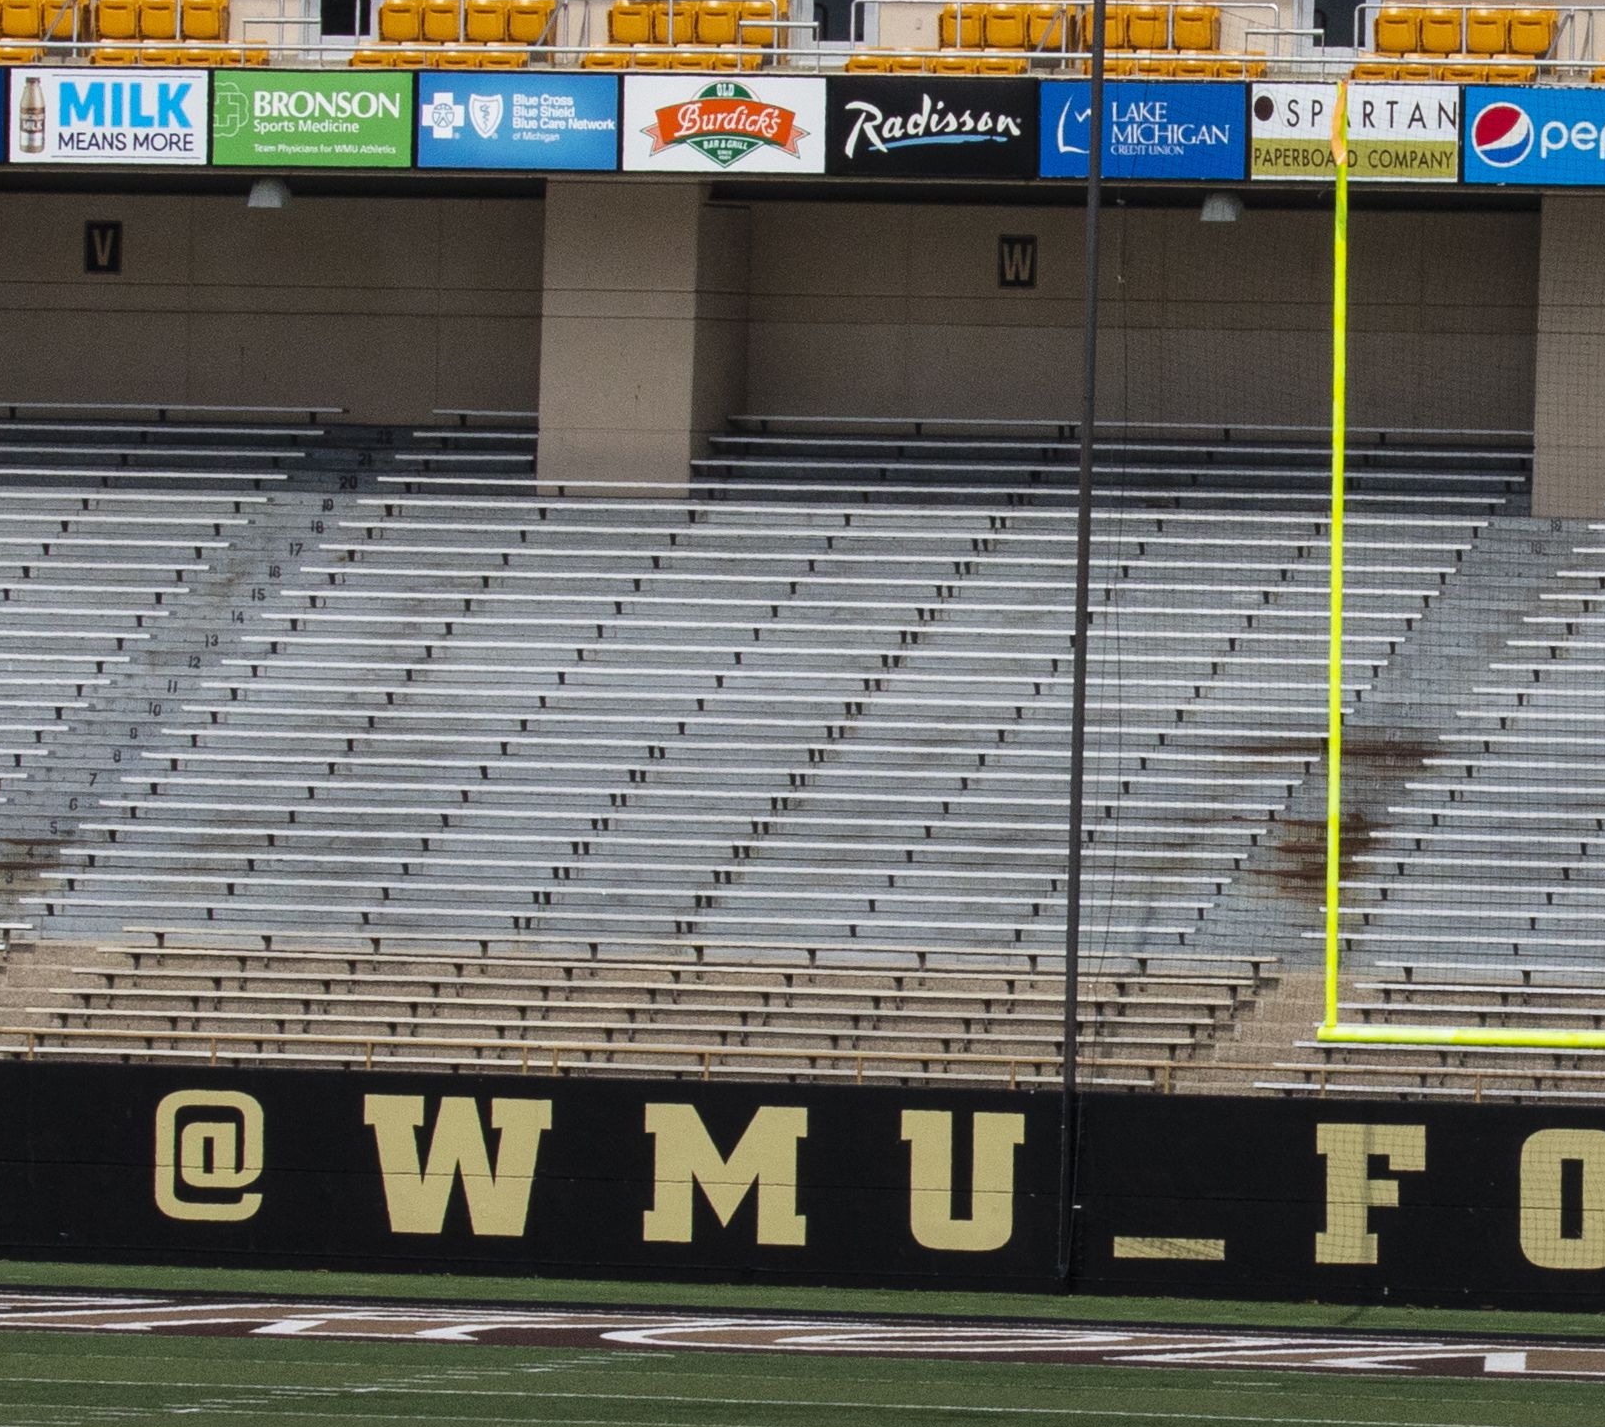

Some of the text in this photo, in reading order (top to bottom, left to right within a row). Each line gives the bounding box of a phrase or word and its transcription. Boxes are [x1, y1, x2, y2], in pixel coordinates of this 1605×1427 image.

[513, 94, 573, 105] Blue Cross
[717, 83, 734, 97] OLD
[60, 83, 190, 127] MILK
[254, 91, 400, 117] BRONSON
[513, 106, 575, 117] Blue Shield
[1112, 102, 1166, 122] LAKE
[1287, 99, 1457, 129] SPRTAN
[254, 119, 359, 134] Sports Medicine
[512, 117, 615, 130] Blue Care Network
[674, 102, 782, 137] Burdick's
[845, 94, 1019, 158] Radisson
[58, 133, 194, 151] MEANS MORE
[1112, 123, 1229, 144] MICHIGAN
[1111, 145, 1184, 155] CREDIT UNION
[1254, 147, 1453, 169] PAPERBOAD COMPANY
[92, 229, 115, 266] V
[1002, 243, 1033, 280] W
